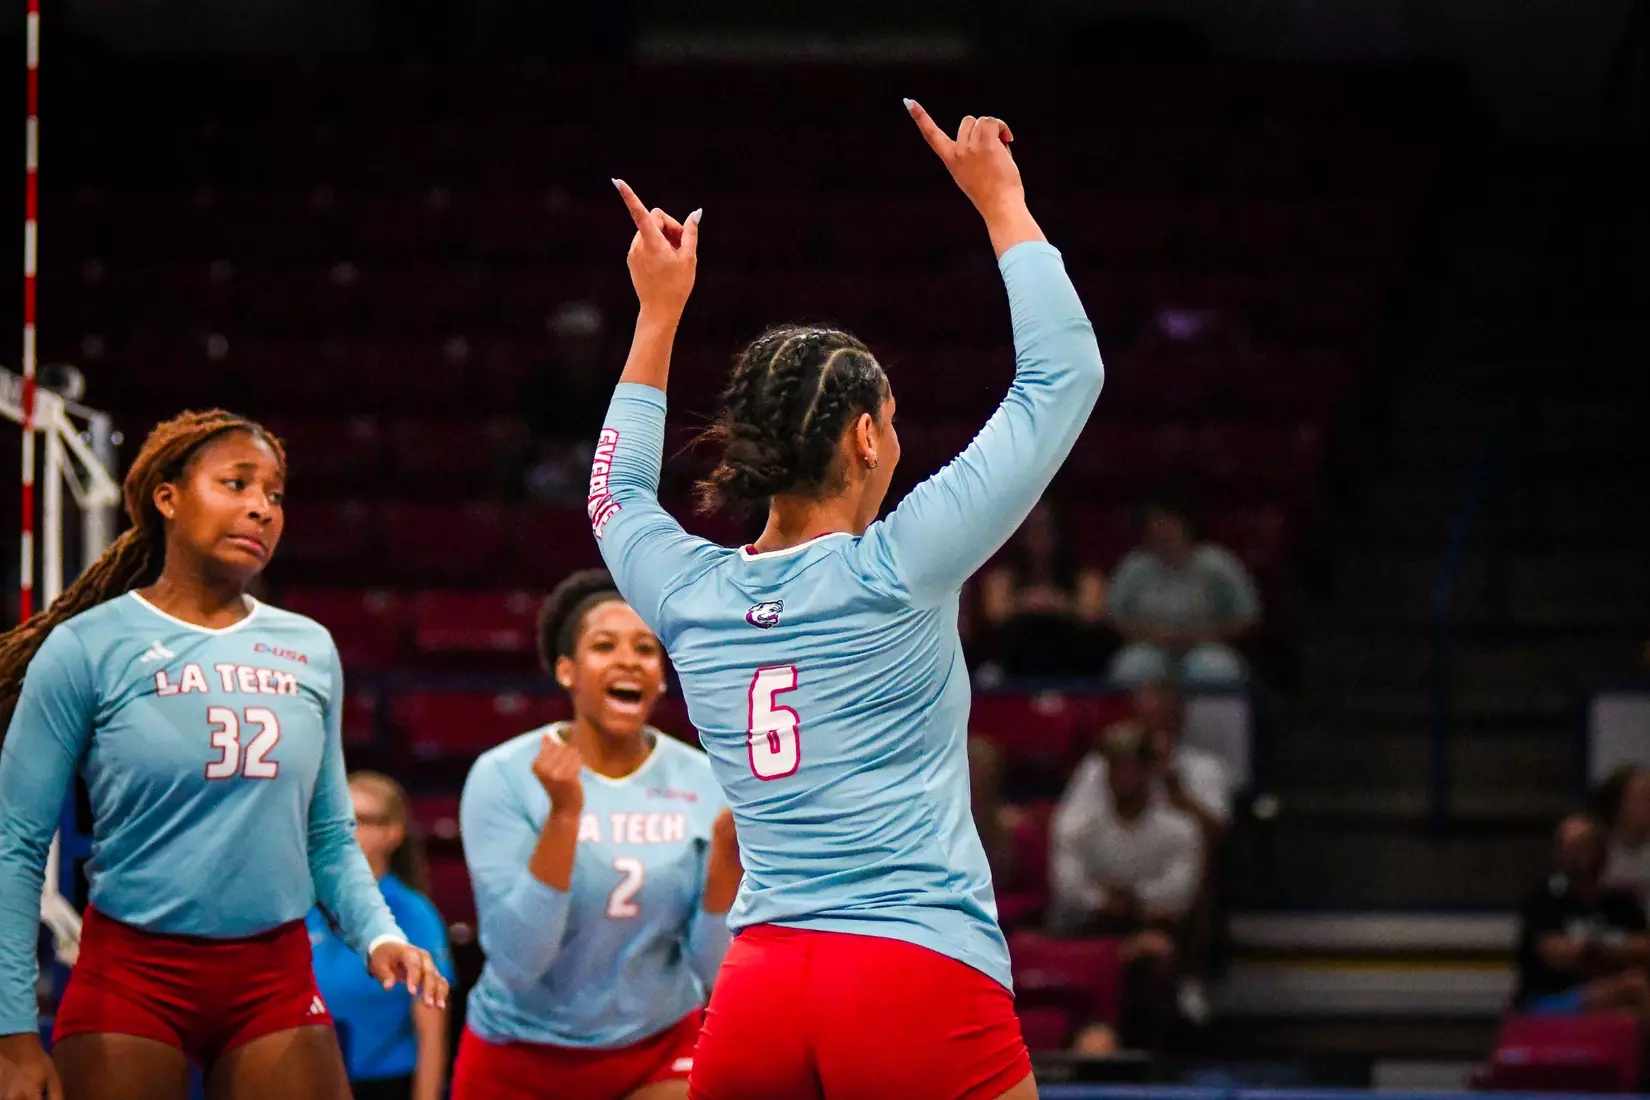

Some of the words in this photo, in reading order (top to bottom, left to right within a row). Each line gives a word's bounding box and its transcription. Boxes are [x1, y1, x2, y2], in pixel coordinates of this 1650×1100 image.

[156, 663, 209, 696] LA
[214, 663, 300, 696] TECH
[205, 705, 281, 780] 32
[748, 665, 801, 782] 6
[577, 813, 602, 843] A
[610, 812, 686, 844] TECH
[606, 857, 645, 919] 2
